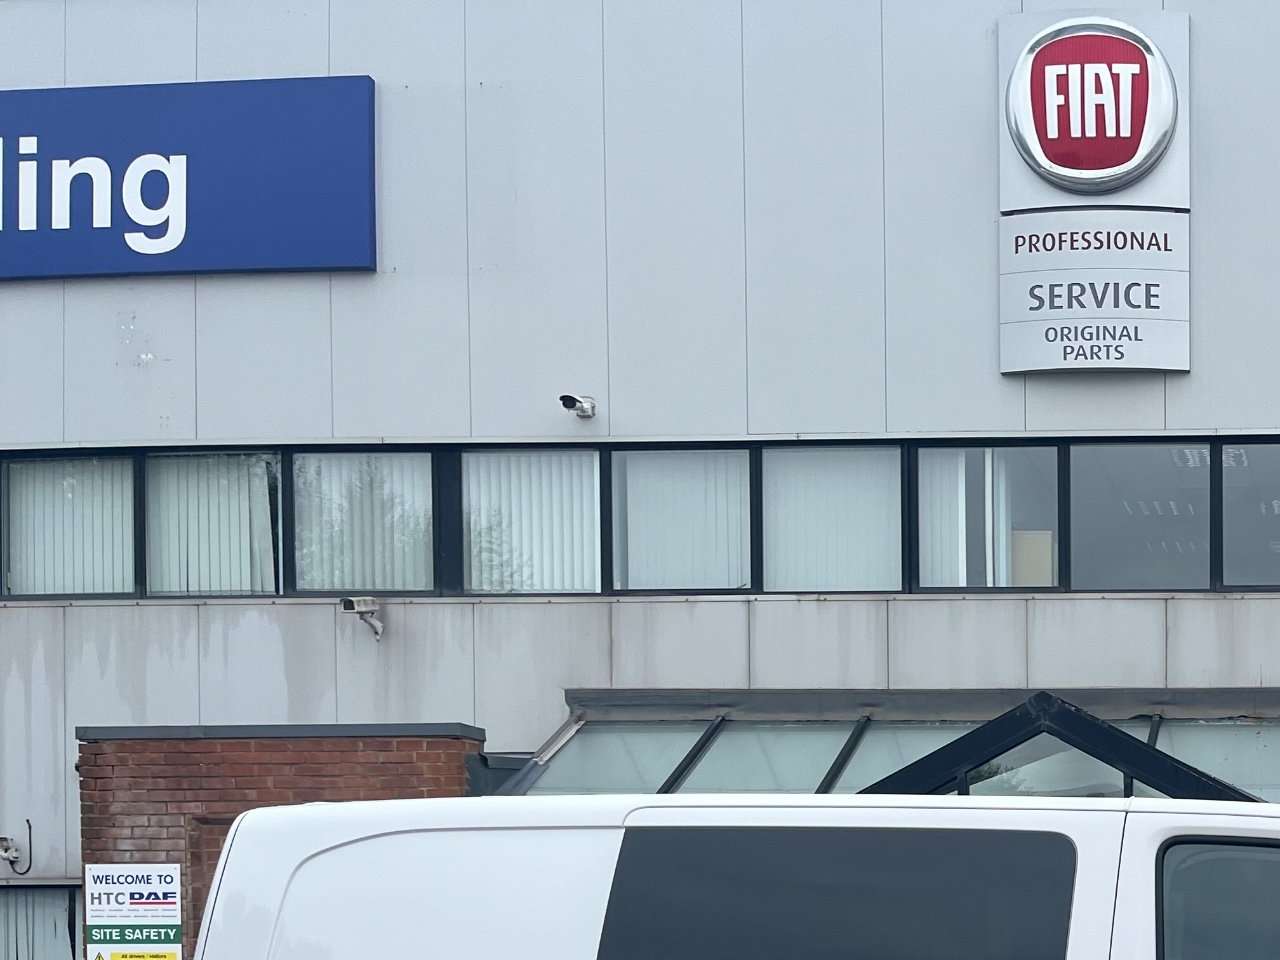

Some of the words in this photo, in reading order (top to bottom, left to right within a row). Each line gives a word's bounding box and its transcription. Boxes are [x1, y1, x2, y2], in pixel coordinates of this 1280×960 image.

[1044, 63, 1140, 139] FIAT
[0, 135, 188, 255] ing
[1014, 231, 1173, 254] PROFESSIONAL
[1028, 282, 1161, 312] SERVICE
[1044, 325, 1143, 343] ORIGINAL
[1063, 344, 1125, 361] PARTS
[92, 874, 152, 885] WELCOME
[157, 874, 174, 885] TO
[90, 892, 126, 906] HTC
[129, 892, 176, 901] DAF
[91, 928, 121, 940] SITE
[124, 928, 177, 940] SAFETY
